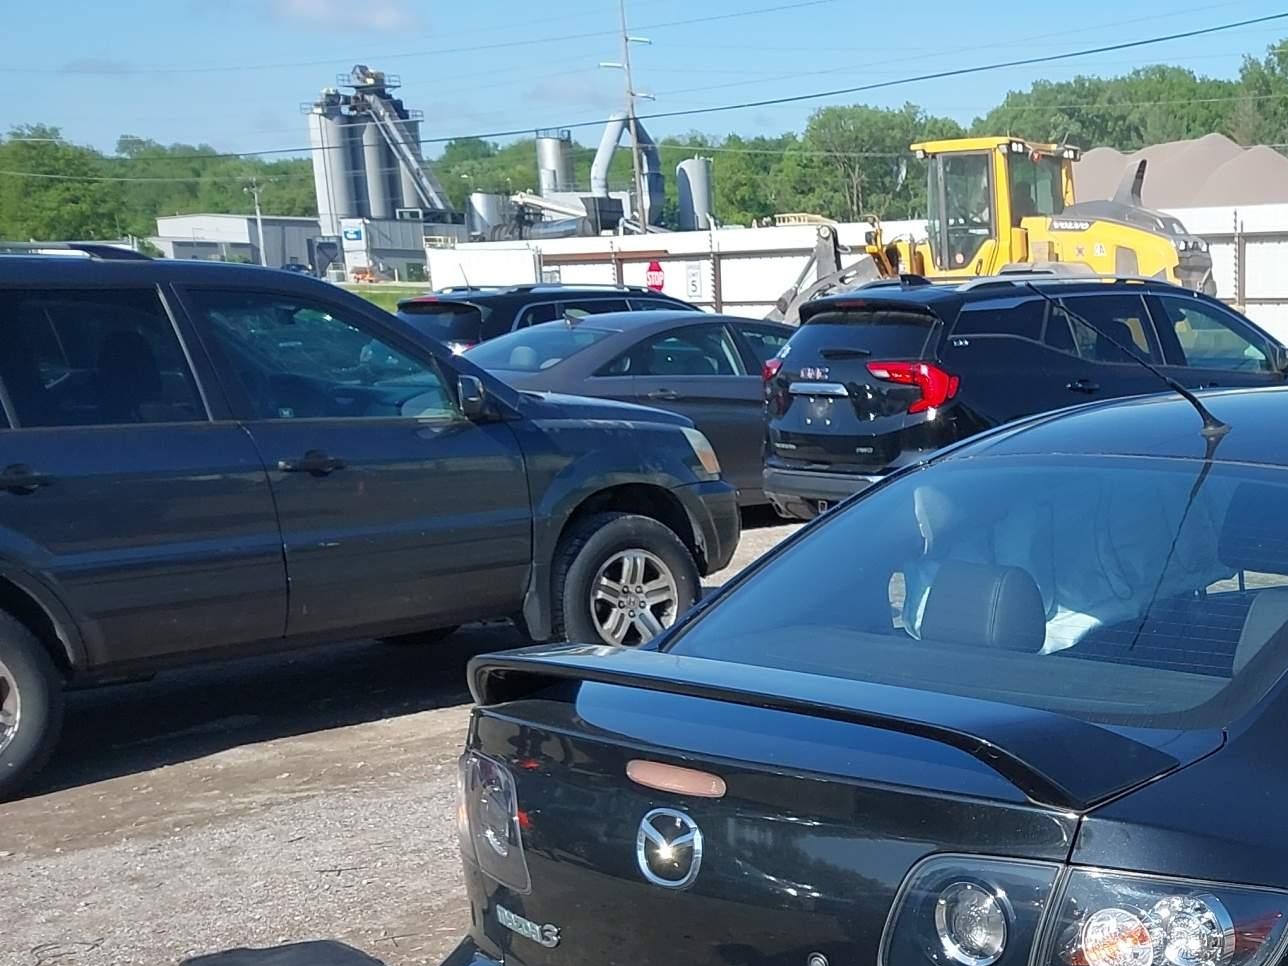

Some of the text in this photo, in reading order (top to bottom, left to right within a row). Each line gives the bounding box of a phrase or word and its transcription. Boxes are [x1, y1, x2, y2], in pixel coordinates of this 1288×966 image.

[1053, 221, 1089, 230] VOLVO
[646, 271, 664, 286] STOP
[691, 280, 698, 293] 5
